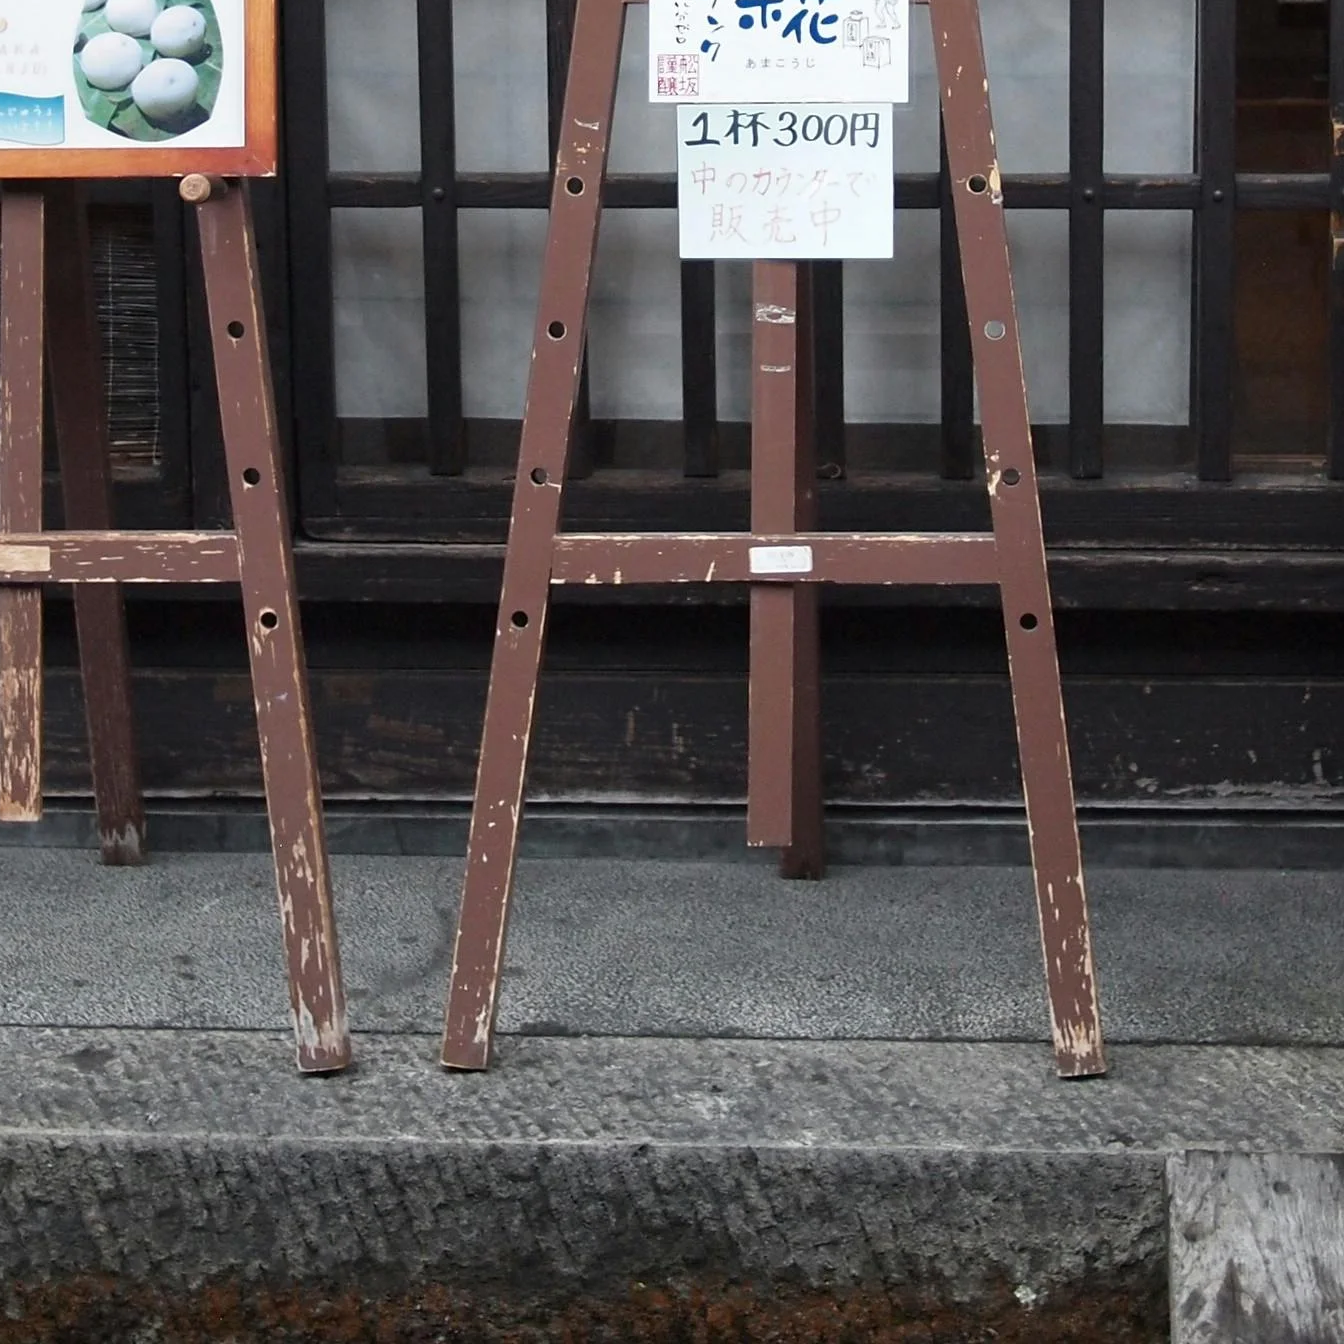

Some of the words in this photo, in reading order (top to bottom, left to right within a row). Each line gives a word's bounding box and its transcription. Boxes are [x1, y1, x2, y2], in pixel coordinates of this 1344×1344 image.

[745, 57, 816, 70] あまこうじ
[684, 110, 880, 149] 1杯300円
[690, 162, 876, 199] 中のカウンターで
[709, 203, 843, 248] 販売中
